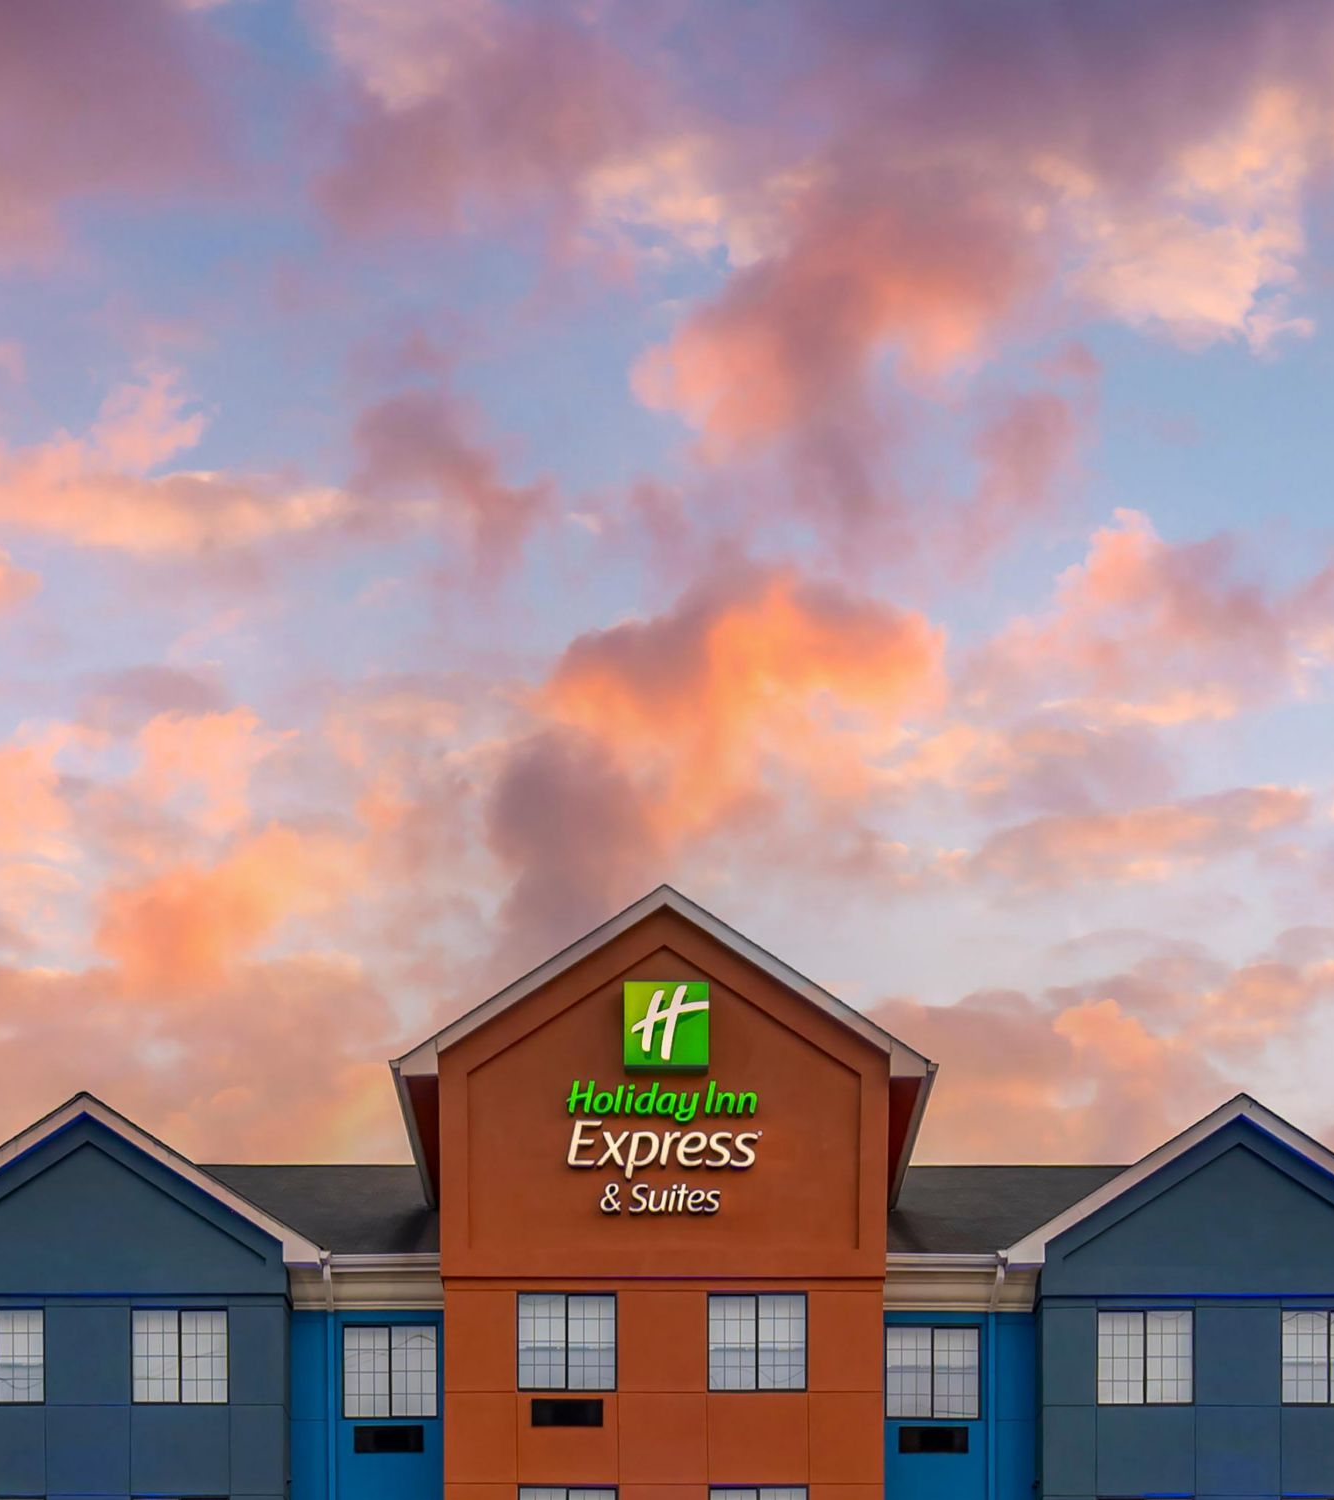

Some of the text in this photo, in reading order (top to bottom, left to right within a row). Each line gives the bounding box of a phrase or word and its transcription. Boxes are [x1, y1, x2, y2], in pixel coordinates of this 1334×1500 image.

[567, 1080, 758, 1122] Holiday Inn
[567, 1120, 759, 1180] Express
[600, 1183, 721, 1213] & Suites
